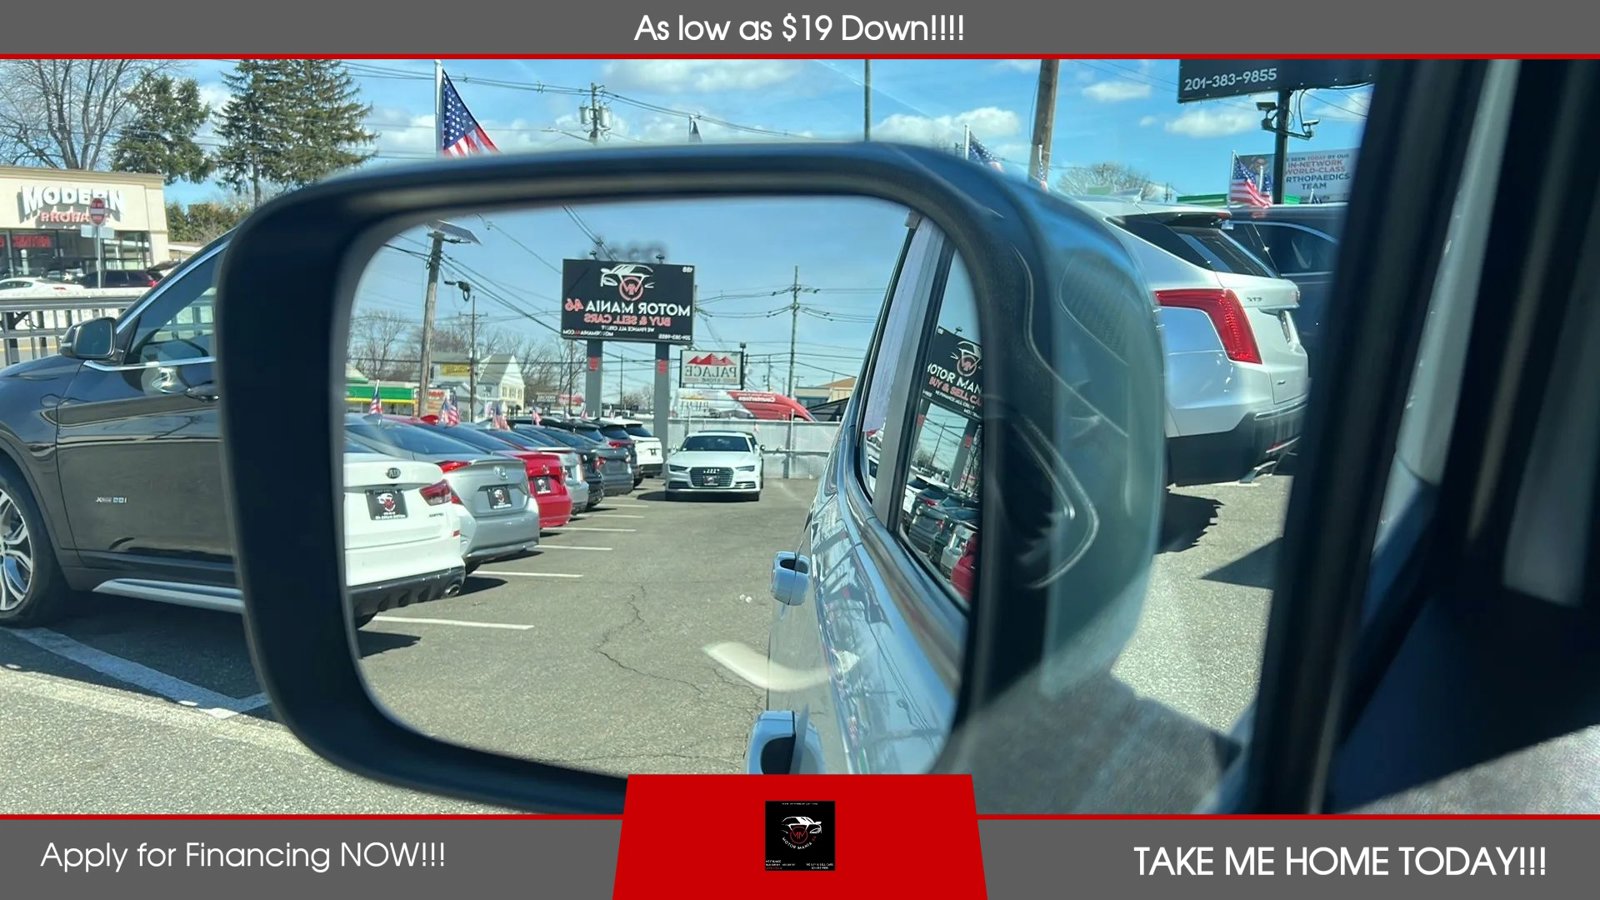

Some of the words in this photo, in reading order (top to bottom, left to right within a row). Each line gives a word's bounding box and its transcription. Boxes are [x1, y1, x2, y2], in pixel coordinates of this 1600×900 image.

[1183, 68, 1278, 91] 201-383-9855
[1287, 159, 1344, 168] IN-NETWORK
[1285, 172, 1352, 183] RTHOPAEDICS
[1301, 182, 1327, 190] TEAM
[21, 185, 124, 216] MODERN
